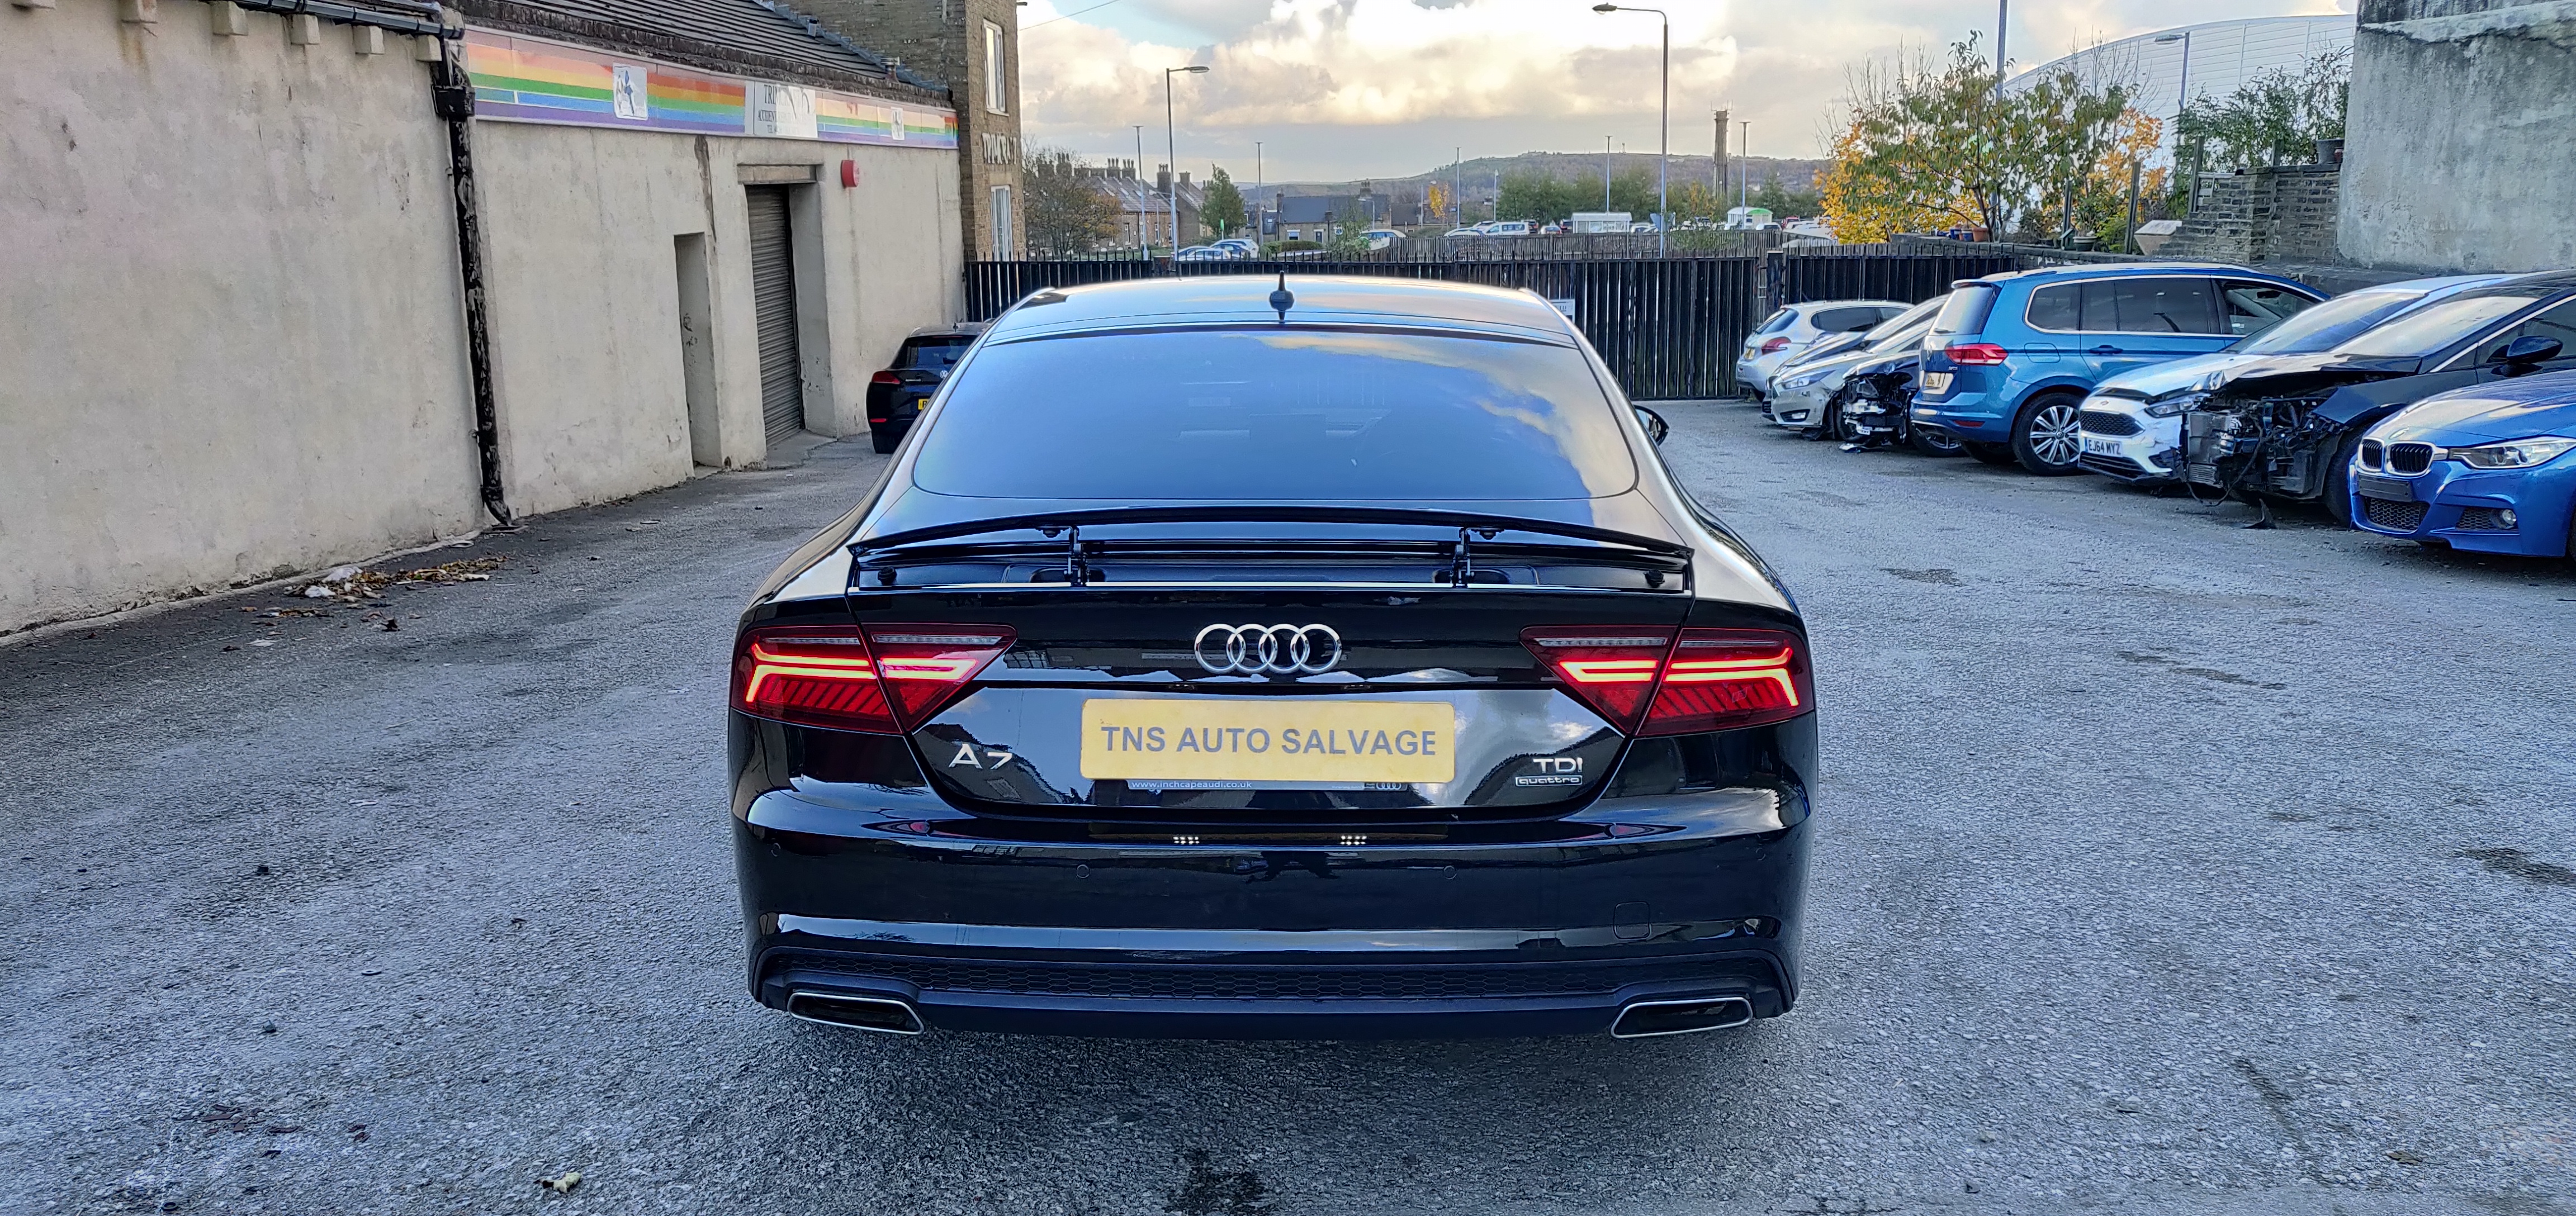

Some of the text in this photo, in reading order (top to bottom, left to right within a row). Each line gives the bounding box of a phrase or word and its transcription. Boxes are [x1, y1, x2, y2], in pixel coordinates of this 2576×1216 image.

[2088, 439, 2121, 455] EJ64 MYZ
[1101, 726, 1436, 756] TNS AUTO SALVAGE
[948, 743, 1012, 770] A7
[1533, 757, 1583, 773] TDI
[1131, 781, 1252, 789] www.inchcapeaudi.co.uk
[1518, 776, 1581, 785] quattro
